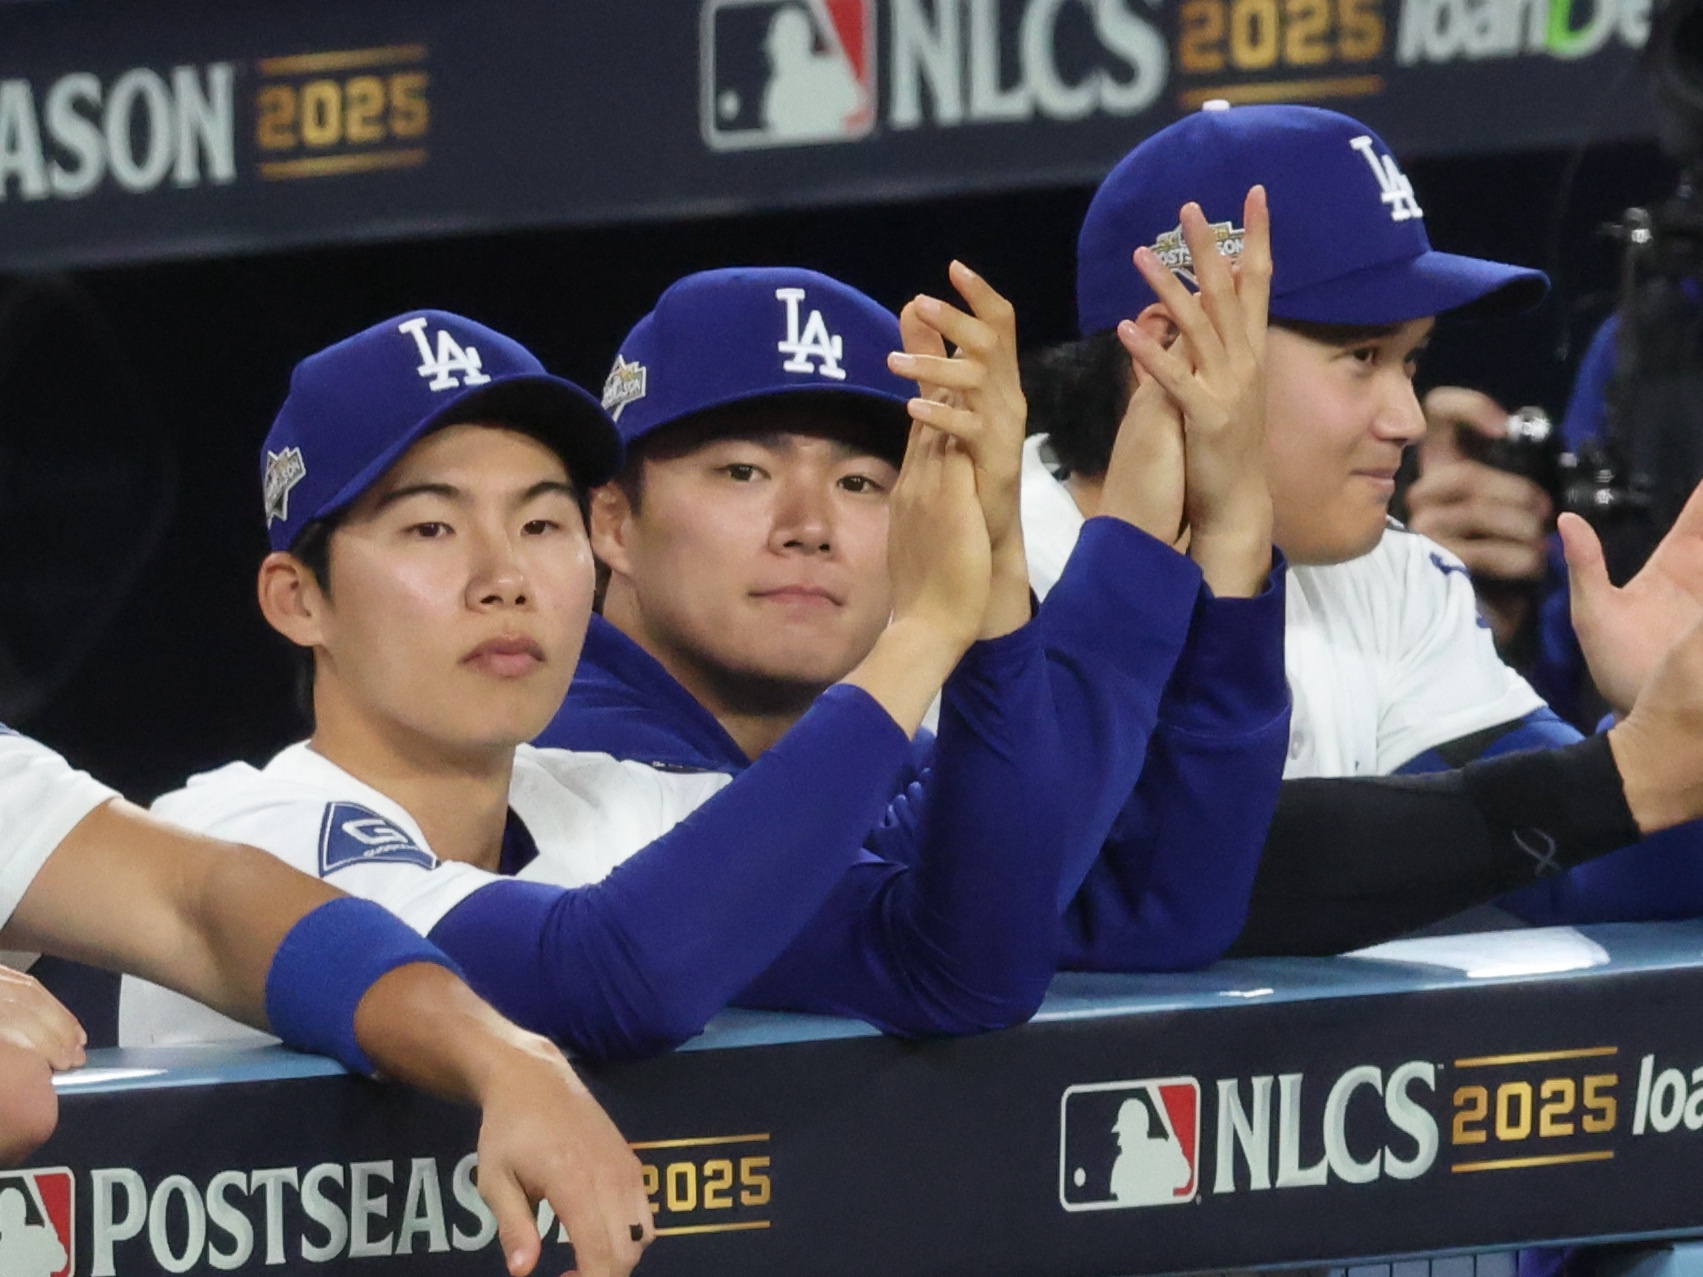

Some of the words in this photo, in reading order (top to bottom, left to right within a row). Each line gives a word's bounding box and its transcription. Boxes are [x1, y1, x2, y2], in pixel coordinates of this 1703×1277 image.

[889, 0, 1169, 130] NLCS
[1180, 0, 1384, 72] 2025
[256, 71, 431, 150] 2025
[1349, 135, 1424, 221] LA
[398, 317, 491, 391] LA
[776, 288, 846, 380] LA
[1212, 1060, 1438, 1194] NLCS
[1452, 1075, 1618, 1145] 2025
